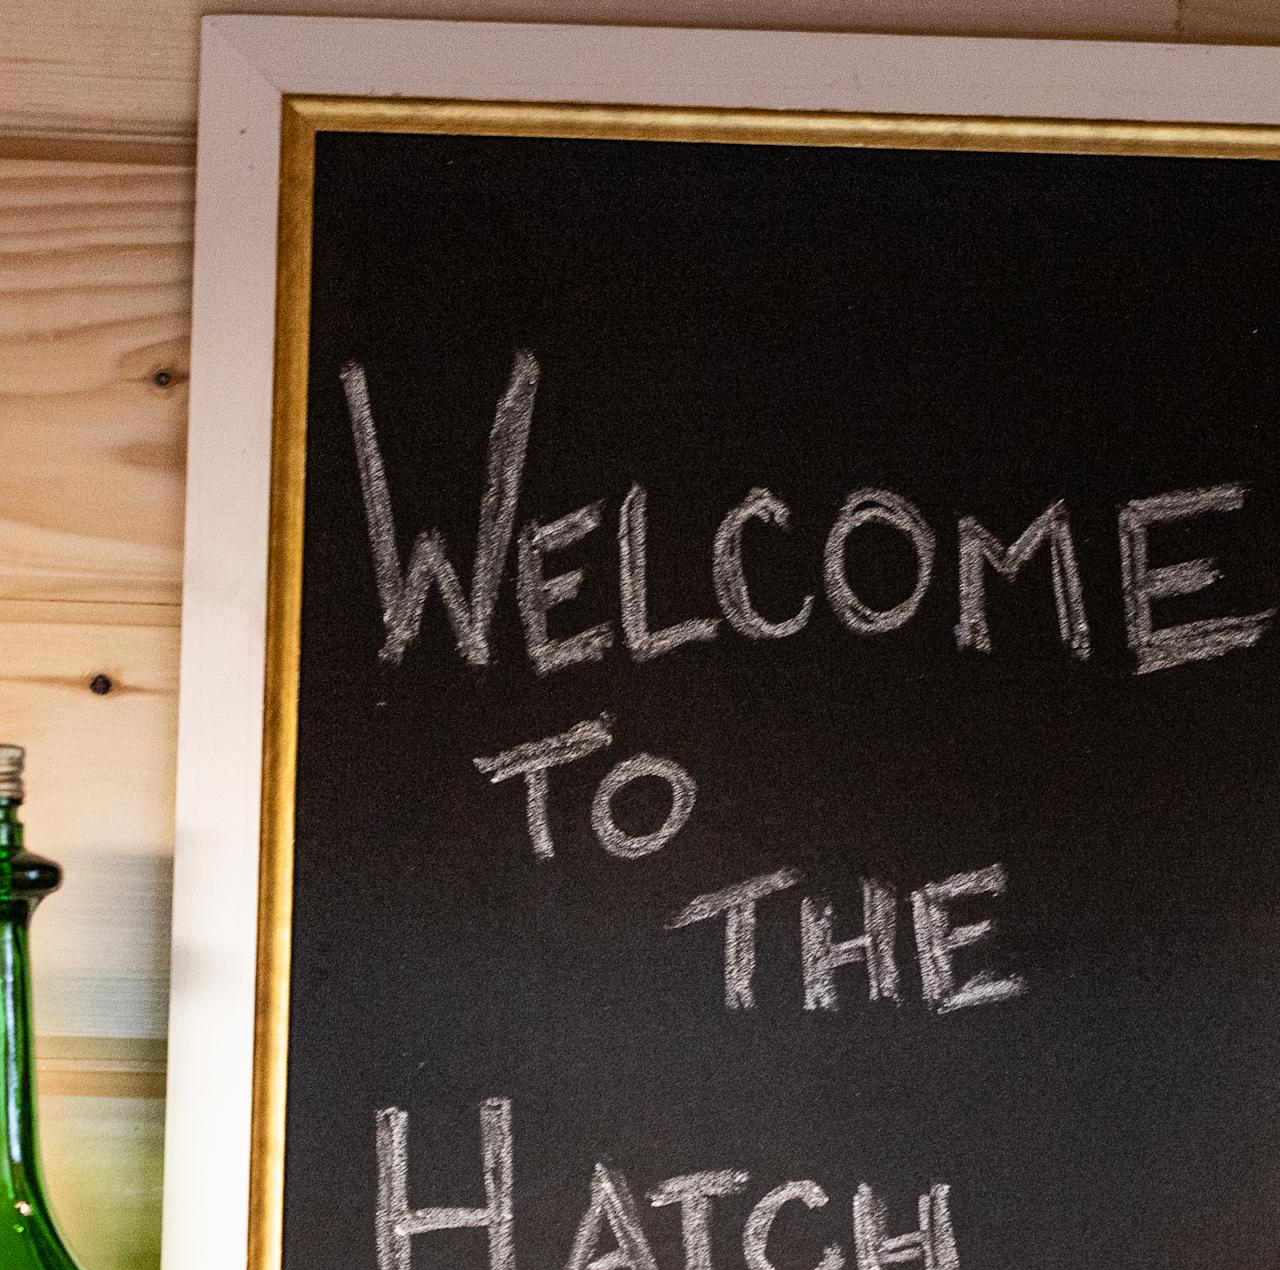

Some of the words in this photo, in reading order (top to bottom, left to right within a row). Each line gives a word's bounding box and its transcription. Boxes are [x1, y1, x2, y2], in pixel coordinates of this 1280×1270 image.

[341, 350, 1276, 675] WELCOME
[473, 711, 697, 860] TO
[664, 862, 1030, 1014] THE
